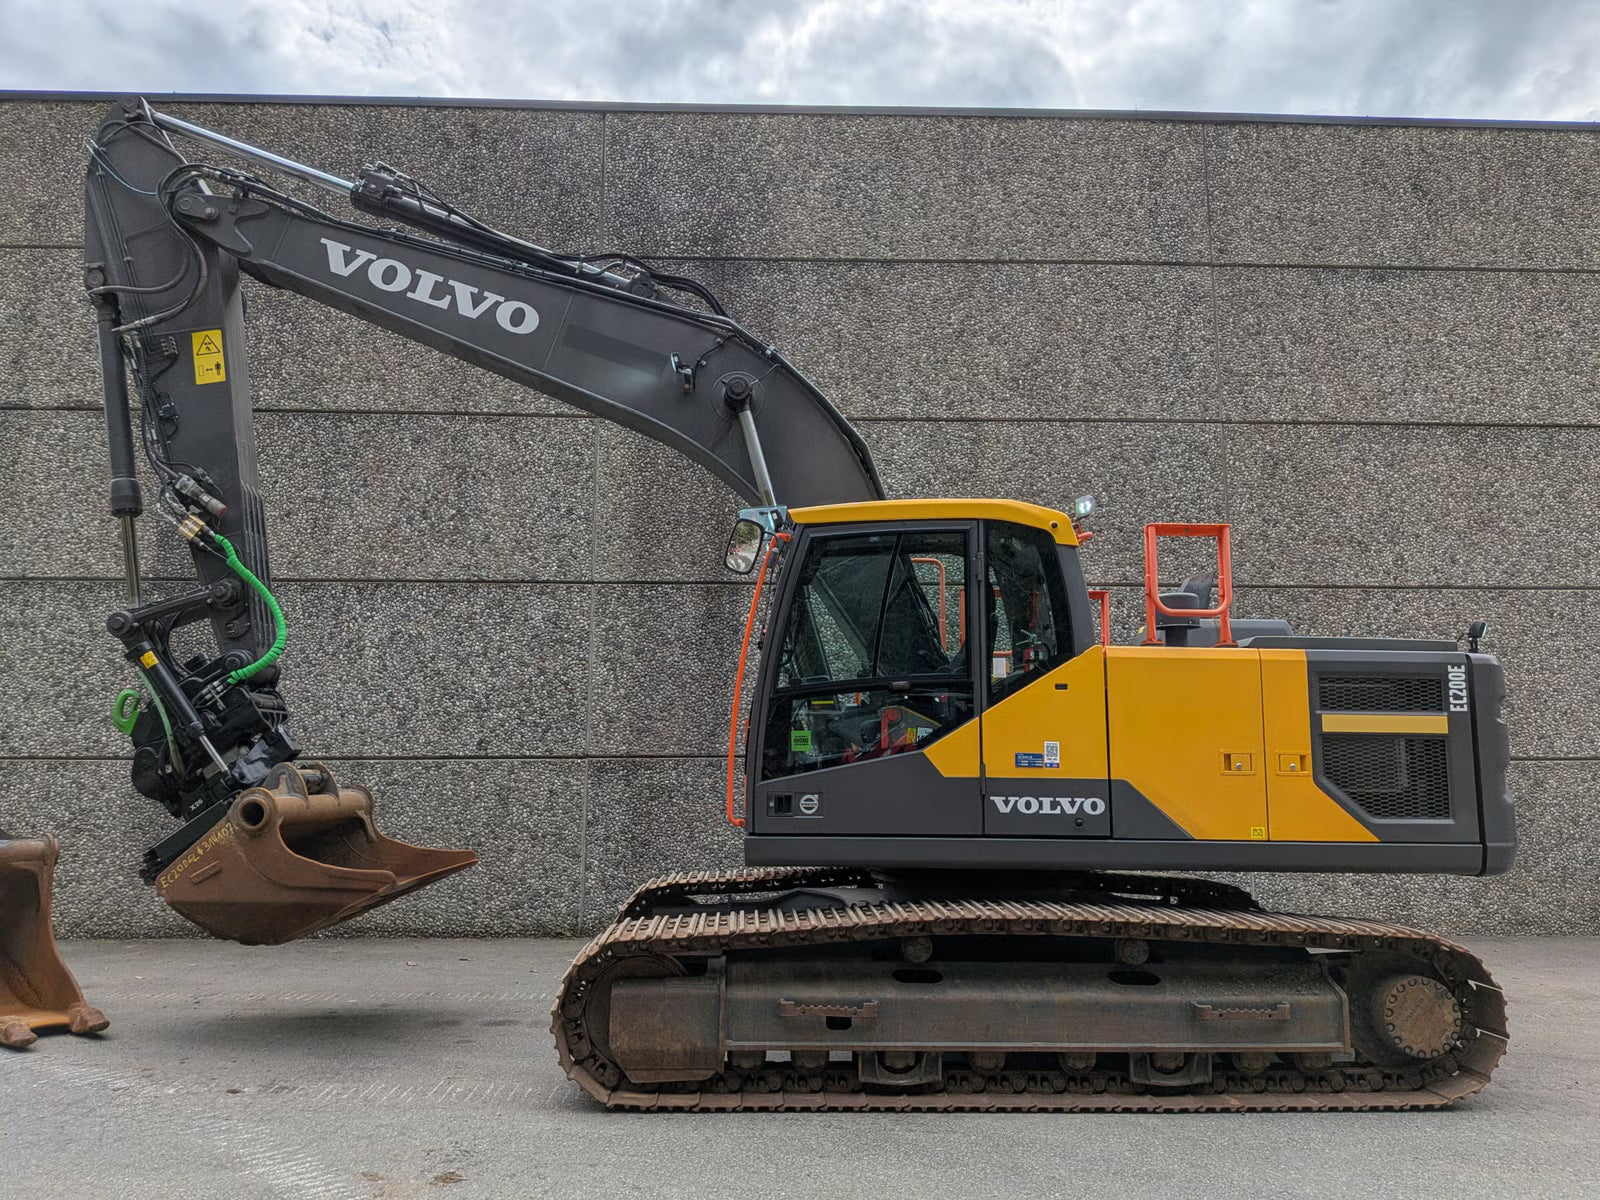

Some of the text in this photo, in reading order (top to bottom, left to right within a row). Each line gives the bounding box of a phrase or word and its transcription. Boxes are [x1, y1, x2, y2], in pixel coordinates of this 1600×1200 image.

[320, 237, 540, 335] VOLVO
[1447, 665, 1468, 712] EC200E
[990, 796, 1106, 815] VOLVO
